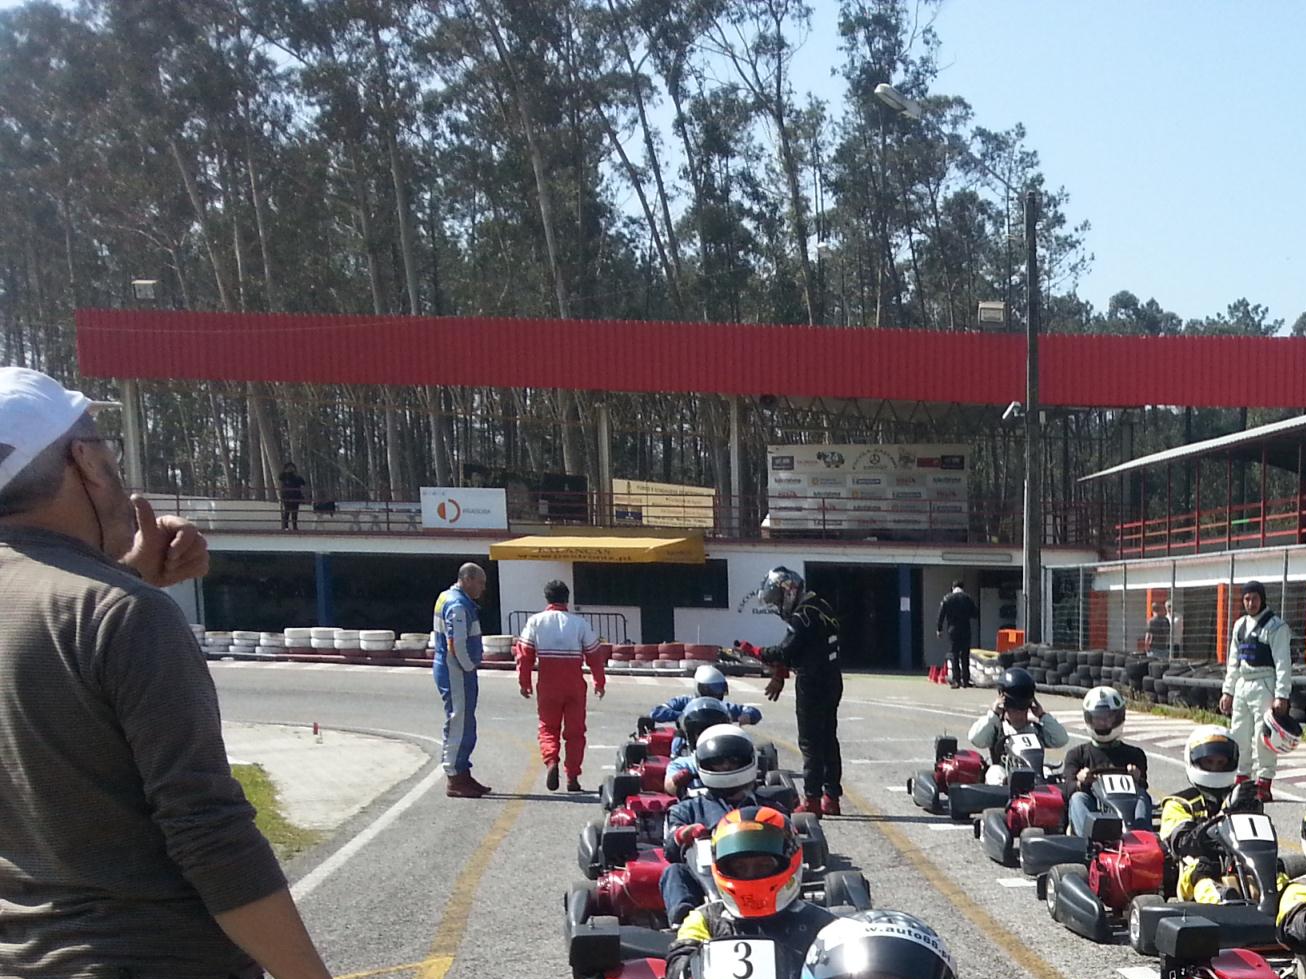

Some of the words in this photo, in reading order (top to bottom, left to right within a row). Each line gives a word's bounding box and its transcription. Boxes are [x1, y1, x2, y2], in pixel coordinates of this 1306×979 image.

[1021, 736, 1032, 748] 9
[1108, 776, 1131, 792] 10
[1248, 817, 1258, 838] 1
